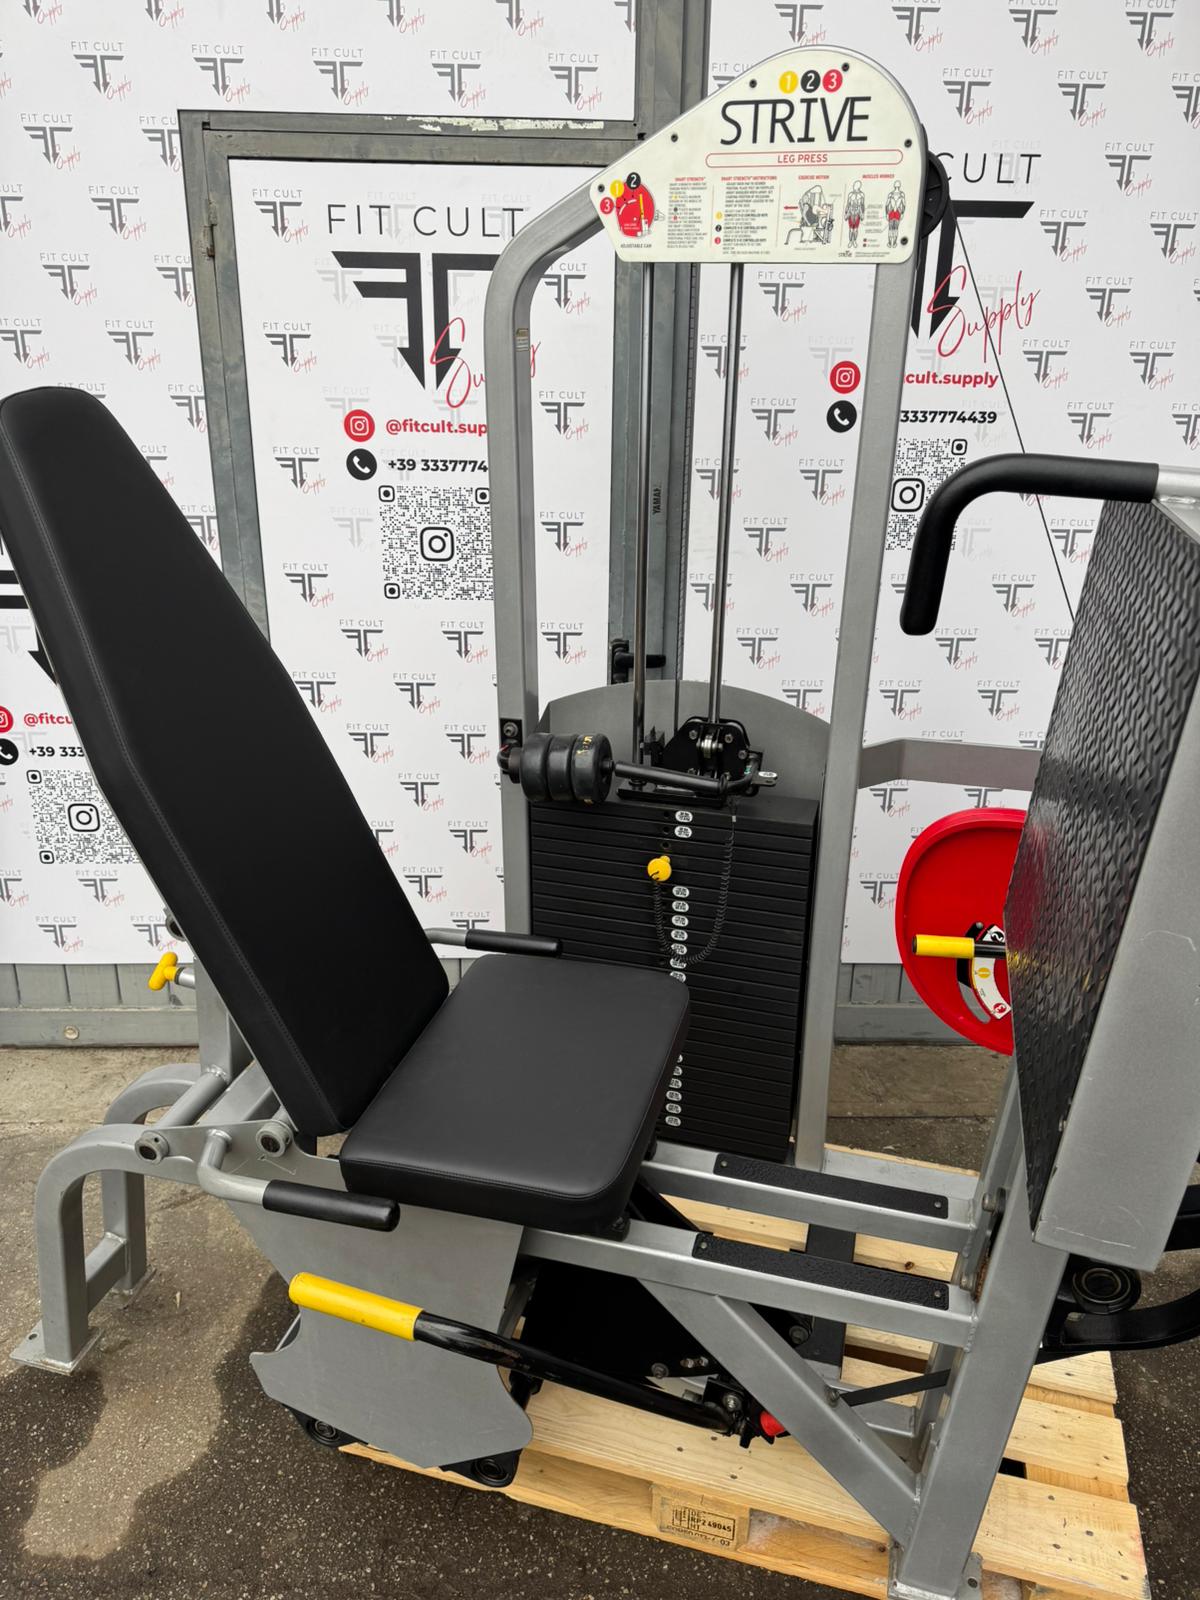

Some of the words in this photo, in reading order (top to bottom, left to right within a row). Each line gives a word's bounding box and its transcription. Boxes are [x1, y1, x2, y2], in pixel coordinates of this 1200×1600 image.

[71, 41, 89, 51] FIT
[93, 41, 124, 52] CULT
[191, 44, 209, 54] FIT
[213, 44, 244, 55] CULT
[312, 48, 330, 57] FIT
[333, 48, 363, 58] CULT
[430, 50, 448, 60] FIT
[451, 50, 481, 61] CULT
[549, 53, 566, 63] FIT
[570, 53, 599, 64] CULT
[943, 68, 960, 77] FIT
[964, 68, 993, 78] CULT
[1058, 71, 1075, 79] FIT
[1079, 71, 1108, 80] CULT
[20, 113, 38, 123] FIT
[42, 113, 73, 124] CULT
[720, 96, 871, 146] STRIVE
[1105, 143, 1122, 151] FIT
[1126, 143, 1154, 152] CULT
[778, 155, 795, 164] LEG
[797, 154, 828, 163] PRESS
[88, 185, 106, 194] FIT
[109, 185, 139, 195] CULT
[252, 188, 270, 198] FIT
[273, 188, 303, 199] CULT
[1040, 209, 1057, 218] FIT
[1061, 209, 1089, 219] CULT
[1150, 211, 1167, 220] FIT
[1171, 211, 1199, 221] CULT
[327, 204, 390, 235] FIT
[413, 205, 525, 237] CULT
[40, 252, 57, 261] FIT
[61, 252, 89, 262] CULT
[560, 263, 587, 271] CULT
[758, 271, 775, 279] FIT
[778, 271, 806, 280] CULT
[1086, 277, 1103, 285] FIT
[1106, 277, 1134, 286] CULT
[927, 264, 1040, 363] Supply
[14, 318, 41, 328] CULT
[105, 320, 122, 328] FIT
[125, 320, 153, 329] CULT
[263, 322, 280, 330] FIT
[283, 322, 311, 331] CULT
[1022, 339, 1039, 347] FIT
[1042, 339, 1070, 348] CULT
[1129, 341, 1146, 349] FIT
[1149, 341, 1177, 350] CULT
[903, 371, 999, 388] cult.supply
[539, 391, 555, 399] FIT
[559, 391, 586, 400] CULT
[750, 398, 766, 406] FIT
[770, 398, 797, 407] CULT
[1067, 402, 1083, 410] FIT
[1087, 402, 1114, 411] CULT
[900, 410, 997, 424] 3337774439
[386, 419, 488, 435] @fitcult.sup
[272, 446, 289, 454] FIT
[292, 446, 320, 455] CULT
[388, 459, 416, 471] +39
[421, 459, 488, 472] 3337774
[799, 459, 815, 467] FIT
[818, 459, 845, 467] CULT
[540, 512, 555, 520] FIT
[558, 512, 584, 520] CULT
[743, 517, 759, 526] FIT
[762, 517, 788, 526] CULT
[1051, 519, 1066, 527] FIT
[1069, 519, 1095, 527] CULT
[283, 563, 299, 571] FIT
[302, 563, 328, 571] CULT
[790, 573, 805, 581] FIT
[808, 573, 834, 581] CULT
[992, 574, 1008, 583] FIT
[1011, 574, 1037, 583] CULT
[339, 619, 354, 627] FIT
[357, 619, 383, 627] CULT
[440, 621, 455, 629] FIT
[458, 621, 484, 629] CULT
[540, 622, 555, 630] FIT
[558, 622, 584, 630] CULT
[736, 627, 751, 636] FIT
[754, 627, 780, 636] CULT
[934, 627, 950, 636] FIT
[953, 627, 979, 636] CULT
[292, 671, 307, 679] FIT
[310, 671, 336, 679] CULT
[393, 673, 408, 681] FIT
[411, 673, 436, 681] CULT
[781, 679, 796, 687] FIT
[799, 679, 824, 687] CULT
[879, 680, 894, 688] FIT
[897, 680, 922, 688] CULT
[977, 680, 992, 688] FIT
[995, 680, 1021, 688] CULT
[346, 723, 361, 731] FIT
[364, 723, 389, 731] CULT
[444, 724, 458, 732] FIT
[462, 724, 486, 732] CULT
[29, 746, 55, 757] +39
[398, 773, 412, 781] FIT
[416, 773, 440, 781] CULT
[448, 820, 462, 828] FIT
[465, 820, 489, 828] CULT
